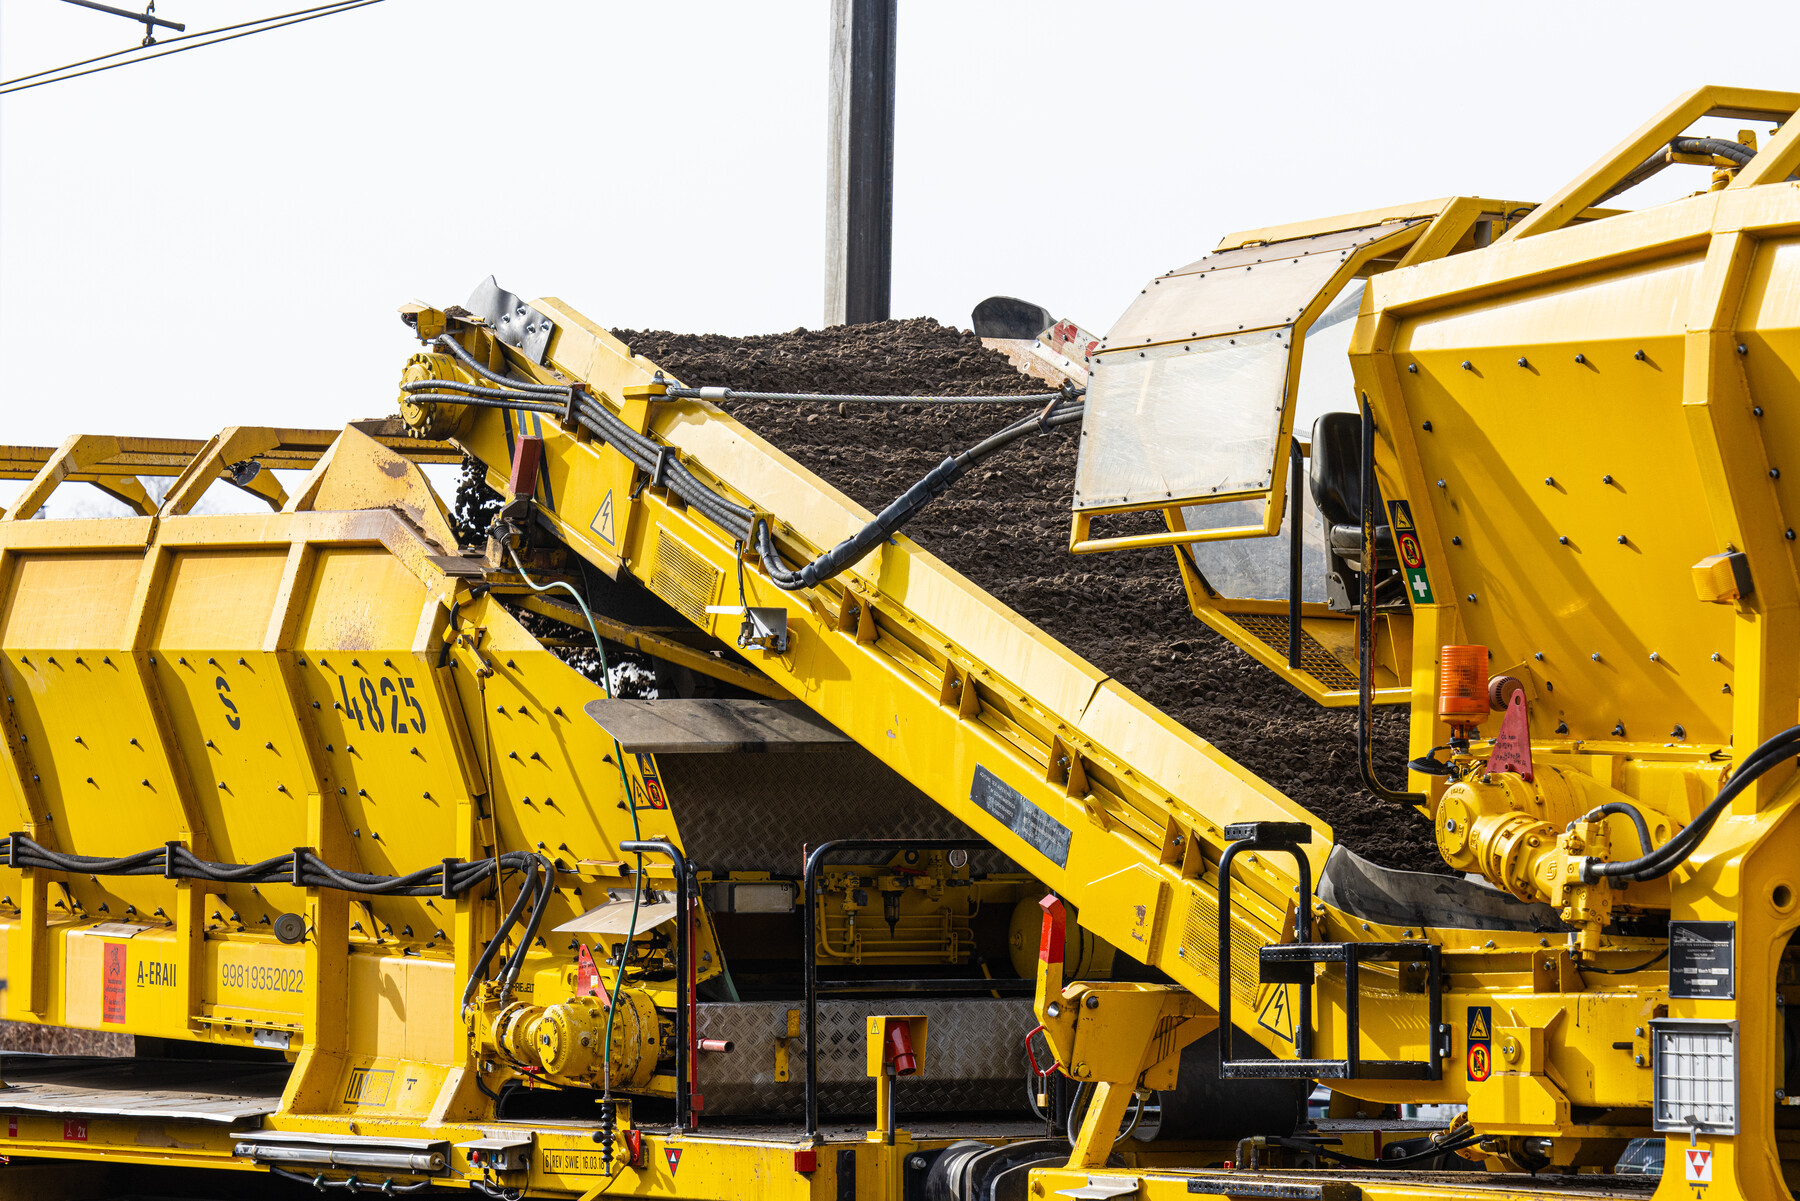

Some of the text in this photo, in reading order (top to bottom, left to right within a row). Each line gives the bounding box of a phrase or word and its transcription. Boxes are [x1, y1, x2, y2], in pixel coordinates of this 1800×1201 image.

[215, 675, 426, 735] S 4825
[552, 1155, 562, 1168] REV
[565, 1155, 579, 1169] SWIE
